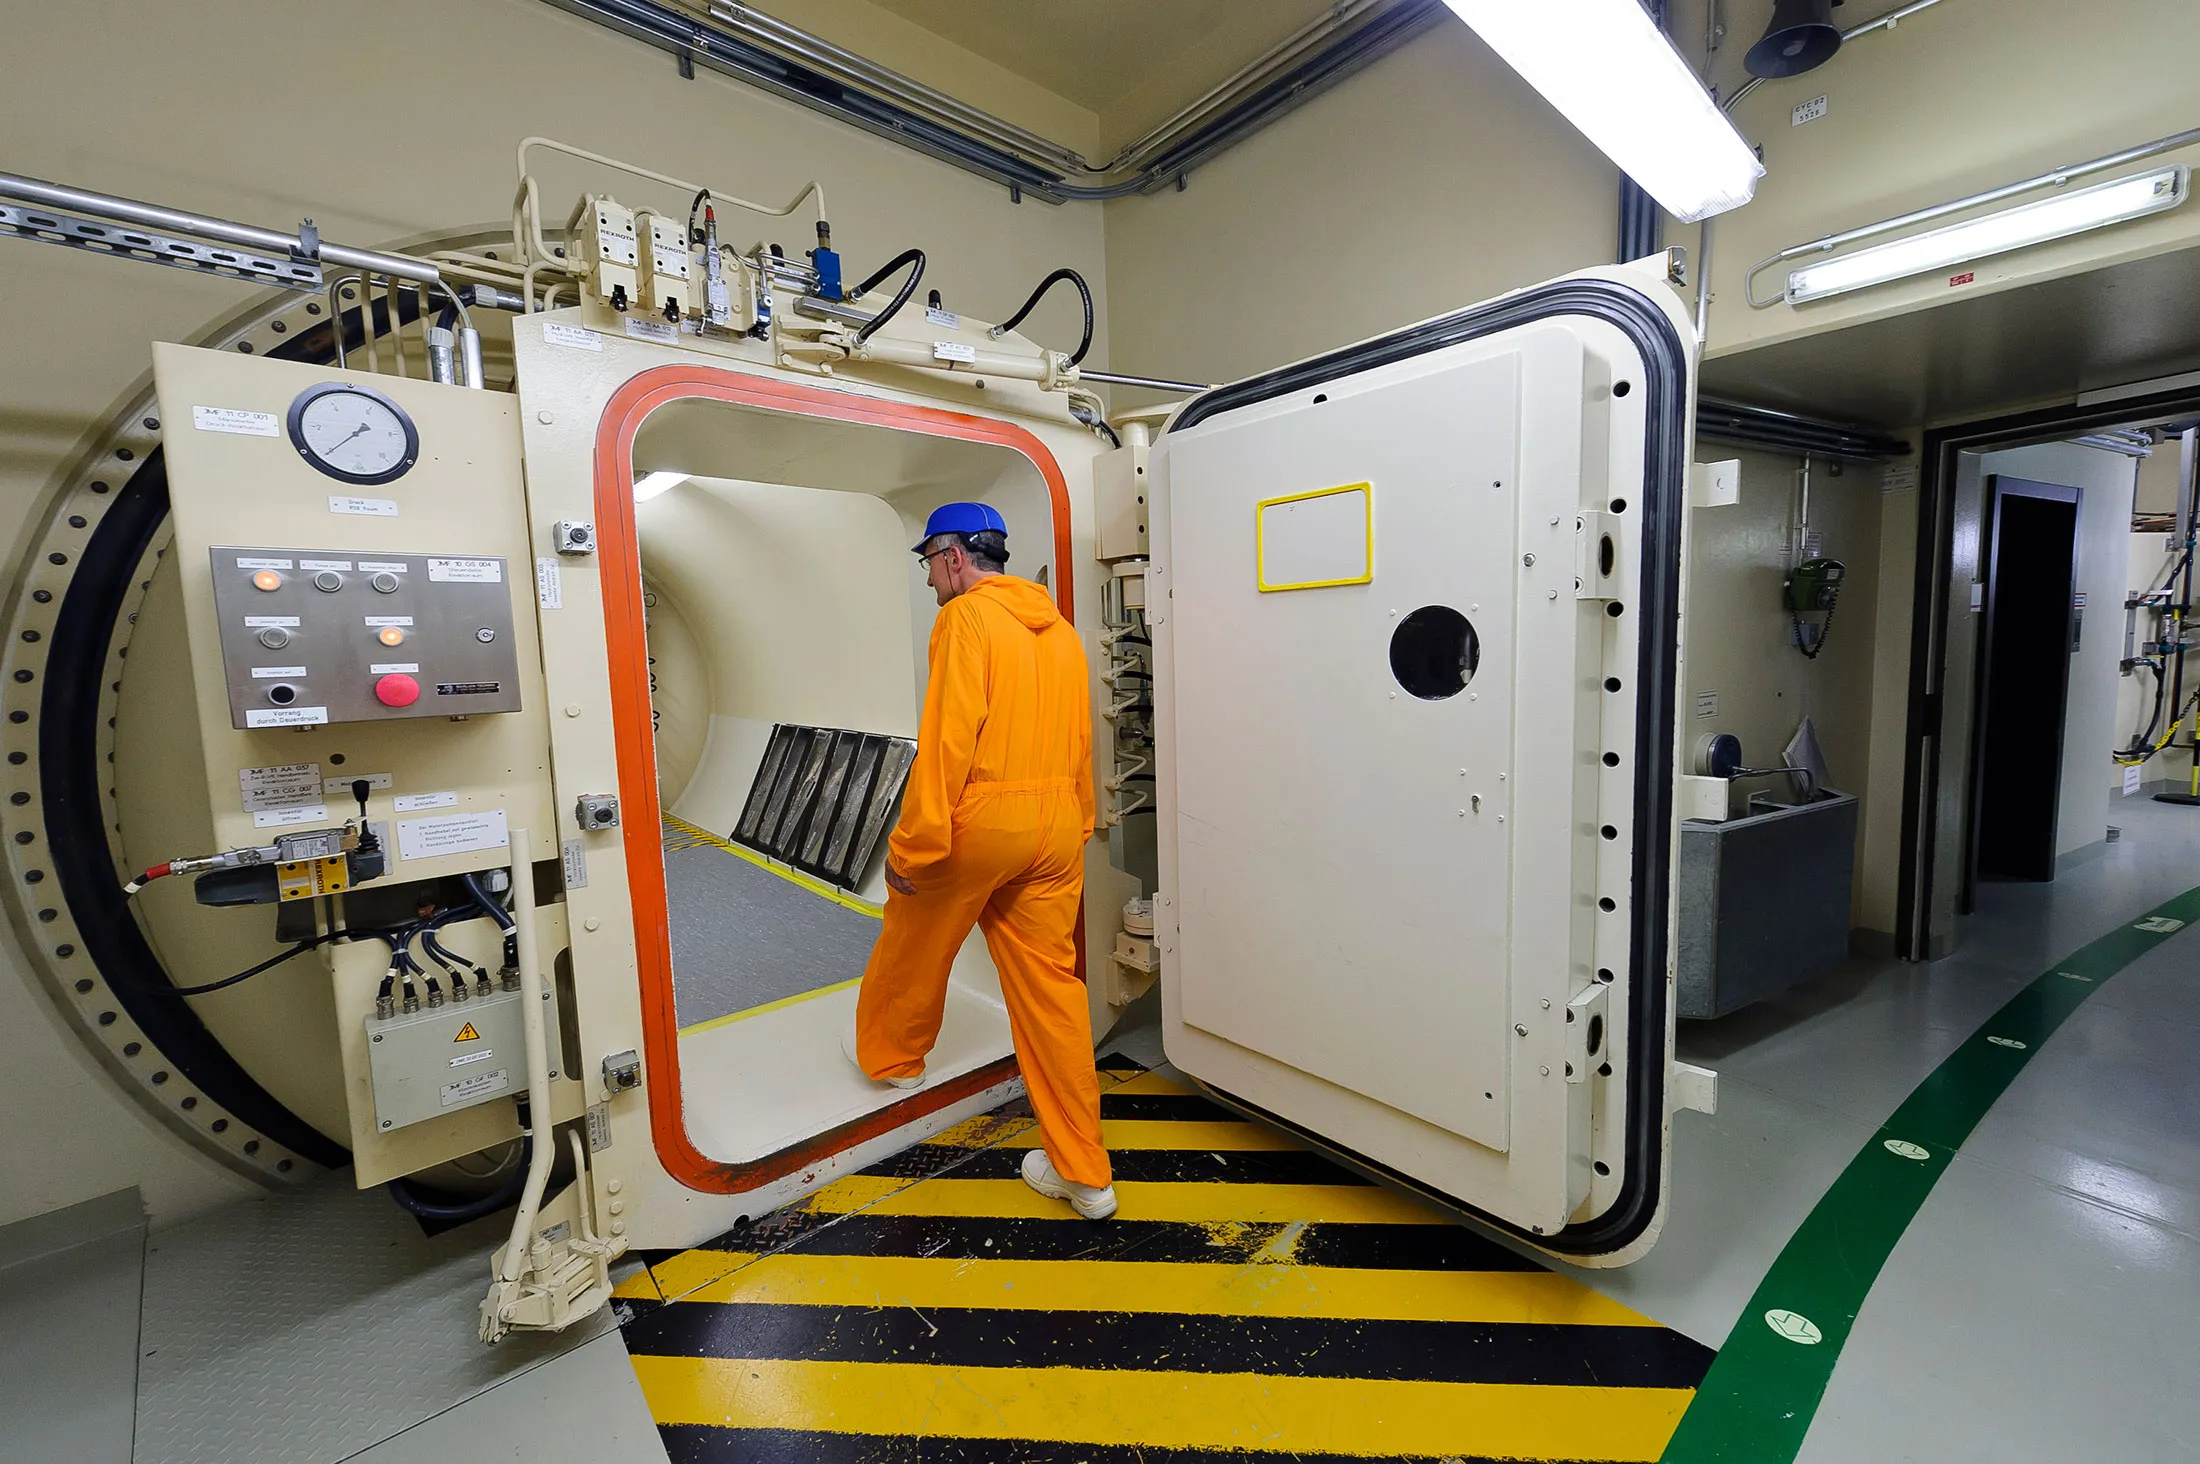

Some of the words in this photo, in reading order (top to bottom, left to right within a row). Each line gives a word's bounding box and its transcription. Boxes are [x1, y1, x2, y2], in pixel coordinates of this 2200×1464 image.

[1795, 102, 1811, 112] CYC
[600, 229, 635, 242] REXROTH
[654, 243, 686, 255] REXROTH
